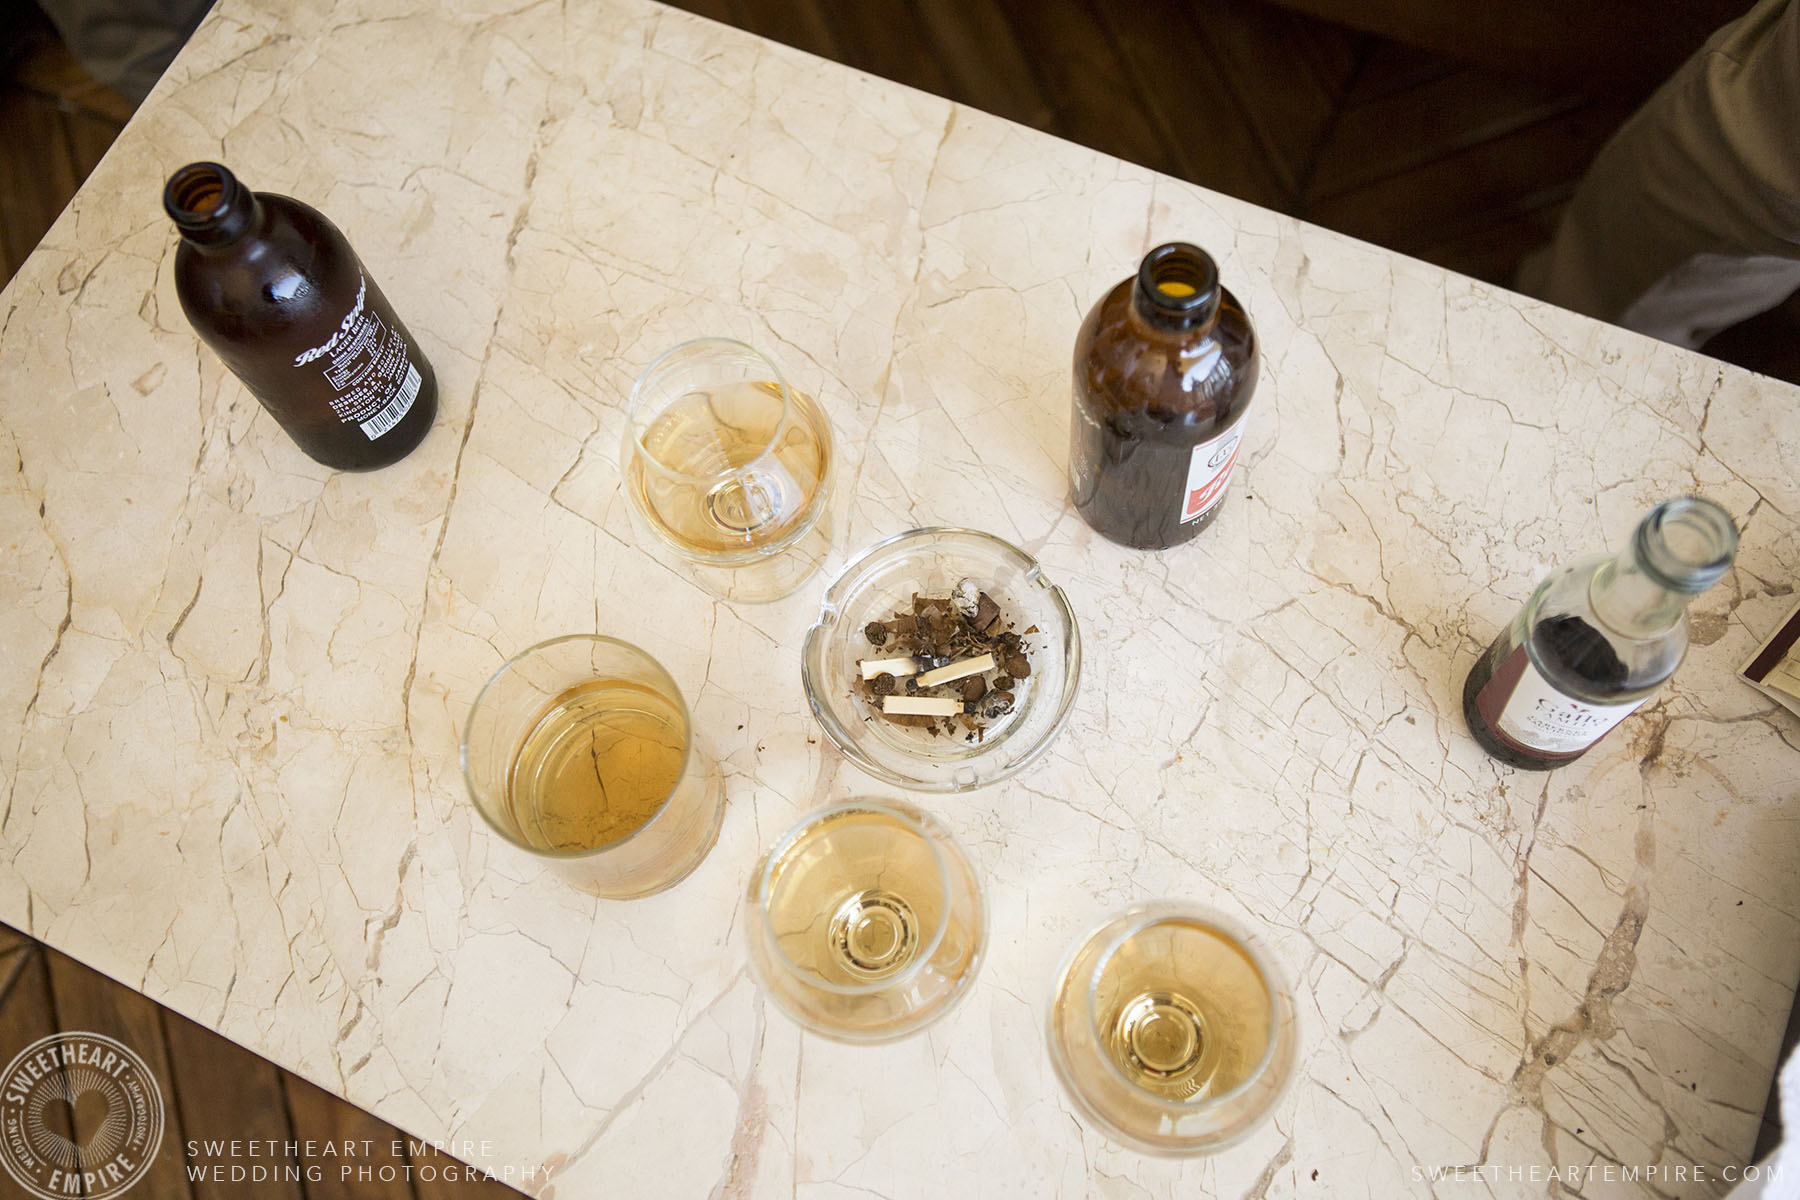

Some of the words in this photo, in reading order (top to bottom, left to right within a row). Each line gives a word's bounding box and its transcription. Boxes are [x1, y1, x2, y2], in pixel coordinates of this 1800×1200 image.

[293, 331, 340, 367] Red
[329, 334, 354, 359] LAGER
[351, 314, 365, 335] BEER
[332, 350, 349, 365] DRINK
[329, 386, 361, 406] BREWED
[364, 371, 377, 387] AND
[377, 337, 392, 371] BOTTLED
[333, 387, 369, 410] DESNOES
[370, 379, 377, 387] &
[378, 348, 395, 378] GEDDES
[336, 405, 350, 414] 214
[353, 379, 383, 407] SPANISH
[383, 356, 396, 378] TOWN
[339, 393, 376, 418] KINGSTON
[387, 351, 401, 382] JAMAICA
[340, 396, 381, 425] PRODUCT
[384, 382, 393, 396] OF
[395, 343, 408, 381] JAMAICA
[352, 363, 375, 387] CONTAINS
[373, 344, 385, 366] BARLEY
[357, 387, 397, 423] MONEY-BACK
